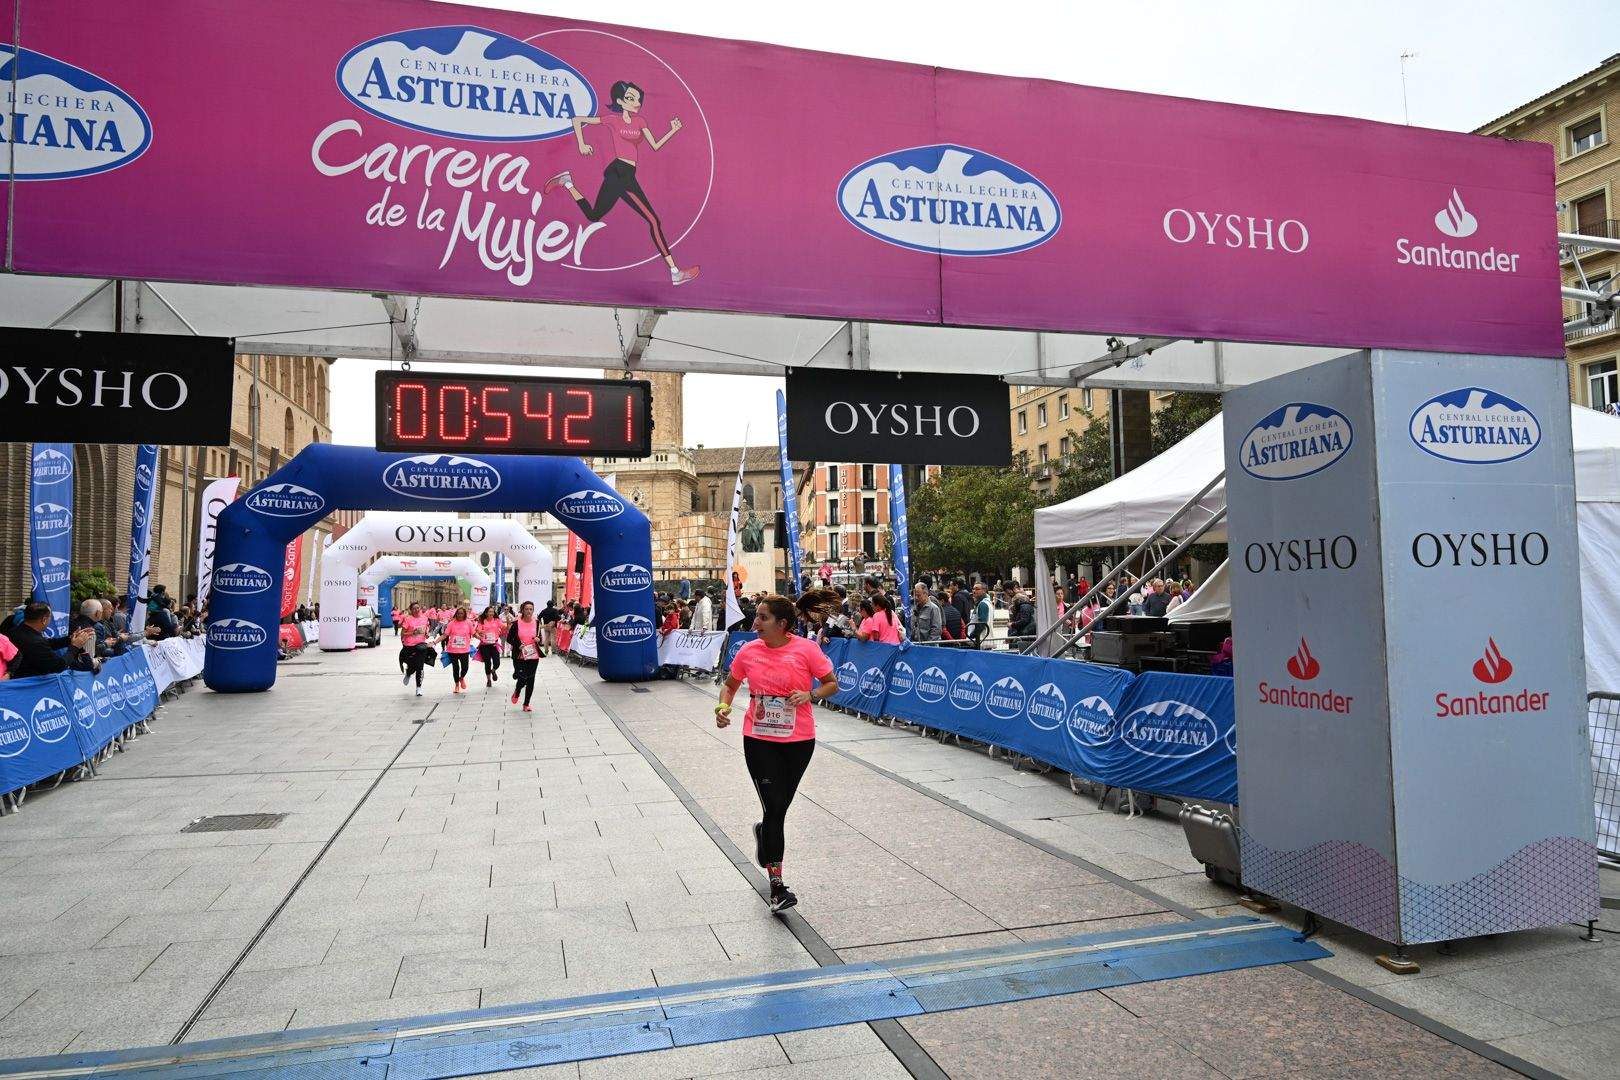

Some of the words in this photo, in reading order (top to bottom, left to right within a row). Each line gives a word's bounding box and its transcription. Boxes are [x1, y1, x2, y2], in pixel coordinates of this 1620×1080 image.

[400, 56, 482, 77] CENTRAL
[491, 69, 571, 87] LECHERA
[357, 56, 576, 120] ASTURIANA
[311, 119, 530, 195] Carrera
[891, 178, 962, 193] CENTRAL
[969, 185, 1038, 200] LECHERA
[856, 178, 1046, 232] ASTURIANA
[365, 186, 408, 227] de
[416, 189, 446, 232] la
[439, 190, 607, 287] Mujer
[1163, 207, 1310, 254] OYSHO
[1396, 238, 1520, 273] Santander
[0, 366, 188, 411] YSHO
[824, 401, 980, 438] OYSHO
[1420, 414, 1533, 446] ASTURIANA
[1439, 413, 1482, 422] CENTRAL
[1485, 415, 1527, 423] LECHERA
[1261, 430, 1296, 443] CENTRAL
[1299, 420, 1339, 436] LECHERA
[1246, 432, 1344, 467] ASTURIANA
[391, 467, 492, 489] ASTURIANA
[250, 494, 319, 510] ASTURIANA
[561, 501, 621, 513] ASTURIANA
[394, 524, 486, 544] OYSHO
[1245, 535, 1357, 574] OYSHO
[1411, 531, 1549, 569] OYSHO
[214, 573, 268, 587] ASTURIANA
[323, 579, 352, 587] OYSHO
[603, 575, 650, 587] ASTURIANA
[208, 628, 262, 642] ASTURIANA
[606, 626, 652, 638] ASTURIANA
[675, 632, 713, 651] OYSHO
[951, 684, 981, 703] ASTURIANA
[987, 689, 1022, 711] ASTURIANA
[1259, 682, 1353, 715] Santander
[1435, 688, 1550, 718] Santander
[0, 727, 29, 746] URIANA
[1125, 718, 1208, 747] ASTURIANA
